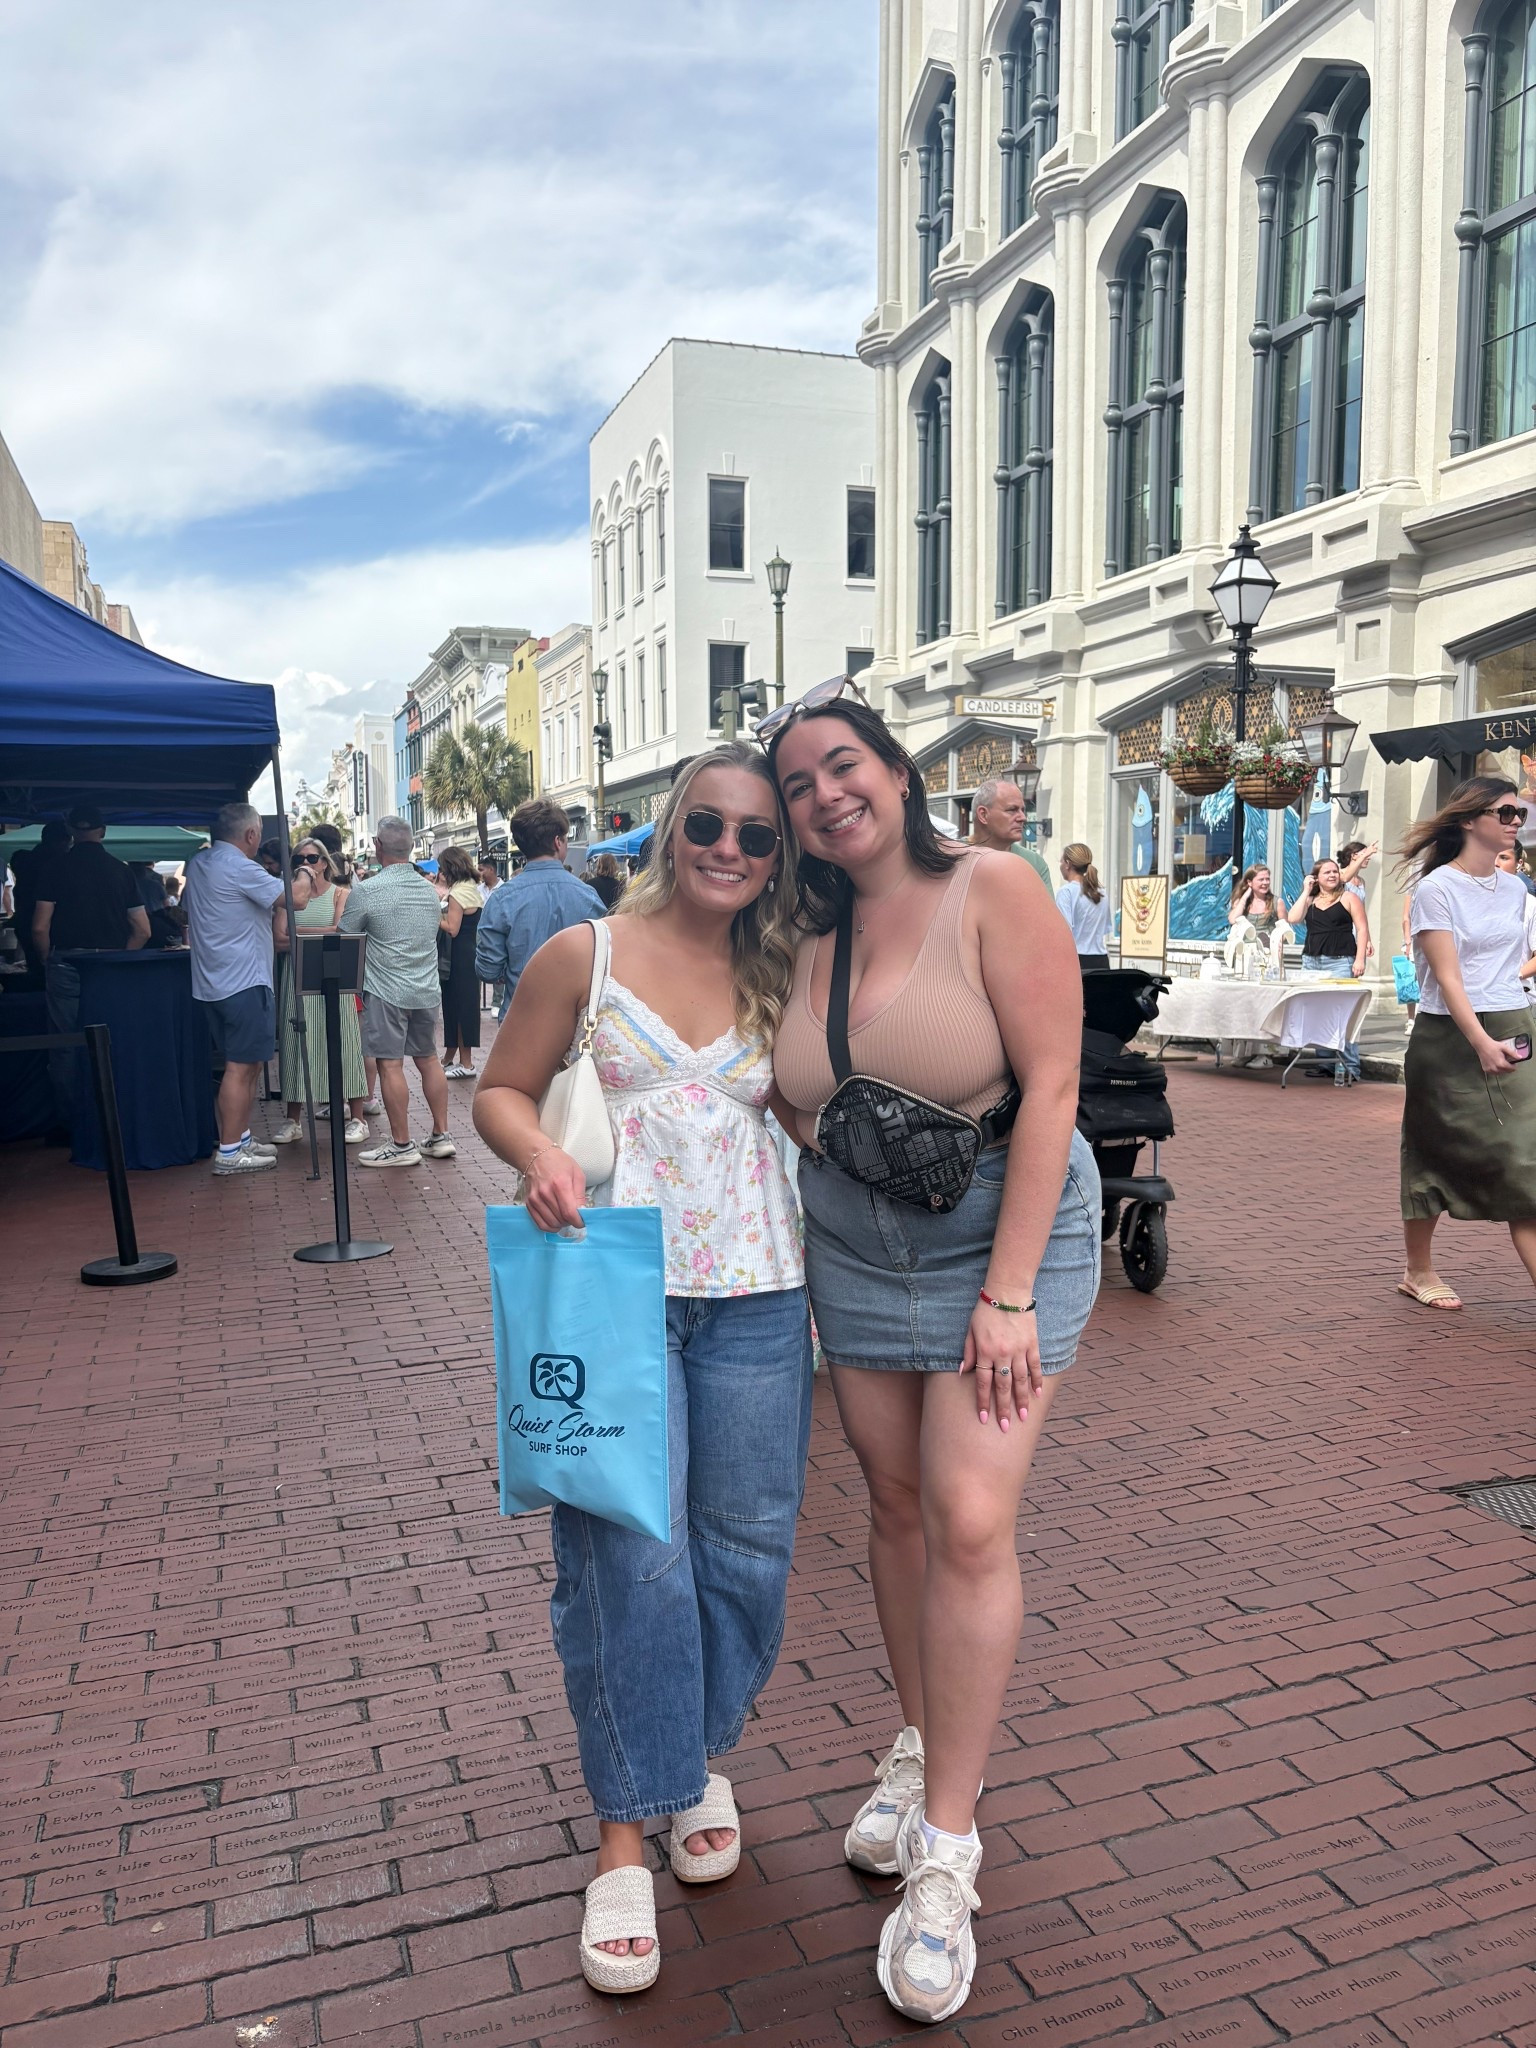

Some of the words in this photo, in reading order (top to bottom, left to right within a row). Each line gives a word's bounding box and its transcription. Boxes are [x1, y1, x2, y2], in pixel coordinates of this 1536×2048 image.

[967, 700, 1039, 714] CANDLEFISH
[1485, 717, 1536, 741] KEN
[508, 1403, 554, 1438] Quiet
[555, 1411, 626, 1442] Storm
[529, 1440, 552, 1454] SURF
[555, 1444, 588, 1457] SHOP
[463, 1511, 500, 1521] Gladwel
[17, 1672, 64, 1686] Garrett
[243, 1680, 264, 1690] Bill
[18, 1692, 73, 1708] Michael
[80, 1682, 128, 1698] Gentry
[756, 1694, 795, 1709] Megan
[851, 1698, 900, 1714] Kenneth
[177, 1713, 207, 1726] Mae
[213, 1704, 260, 1718] Gilmer
[791, 1713, 828, 1728] Grace
[71, 1730, 120, 1746] Gilmer
[241, 1722, 284, 1738] Robert
[305, 1734, 355, 1749] William
[377, 1720, 423, 1737] Gurney
[440, 1727, 503, 1747] Gonzalez
[82, 1754, 122, 1768] Vince
[129, 1745, 179, 1759] Gilmer
[159, 1761, 218, 1780] Michael
[224, 1753, 270, 1768] Gionis
[235, 1776, 268, 1791] John
[275, 1771, 292, 1781] M
[322, 1786, 356, 1800] Dale
[361, 1771, 434, 1792] Gordineer
[48, 1785, 97, 1801] Gionis
[414, 1792, 468, 1811] Stephen
[474, 1780, 526, 1798] Grooms
[52, 1810, 103, 1826] Evelyn
[111, 1805, 124, 1815] A
[497, 1803, 553, 1821] Carolyn
[140, 1820, 198, 1838] Miriam
[29, 1852, 41, 1861] &
[51, 1838, 114, 1856] Whitney
[309, 1846, 368, 1865] Amanda
[374, 1837, 407, 1851] Leah
[412, 1825, 460, 1842] Guerry
[49, 1873, 87, 1888] John
[95, 1868, 108, 1877] &
[117, 1860, 151, 1875] Julie
[159, 1850, 199, 1865] Gray
[1359, 1864, 1408, 1886] Werner
[1411, 1852, 1457, 1873] Erhard
[124, 1889, 165, 1907] Jamie
[171, 1876, 229, 1895] Carolyn
[236, 1863, 287, 1880] Guerry
[1084, 1903, 1116, 1920] Reid
[1119, 1871, 1228, 1911] Cohen-West-Peck
[1457, 1880, 1509, 1903] Norman
[1510, 1877, 1523, 1887] &
[1188, 1887, 1333, 1934] Phebus-Hines-Hawkins
[1420, 1895, 1453, 1912] Hall
[1029, 1945, 1128, 1981] Ralph&Mary
[1129, 1931, 1181, 1955] Briggs
[1430, 1951, 1464, 1969] Amy
[1464, 1946, 1479, 1958] &
[1479, 1933, 1519, 1953] Craig
[1157, 1976, 1192, 1994] Rita
[1193, 1957, 1261, 1983] Donovan
[1261, 1945, 1298, 1963] Hair
[971, 1980, 1014, 2001] Hines
[1291, 1985, 1345, 2010] Hunter
[1348, 1967, 1404, 1993] Hanson
[1001, 2024, 1039, 2042] Olin
[1042, 1995, 1127, 2030] Hammond
[1413, 2003, 1477, 2032] Drayton
[1476, 1986, 1523, 2010] Hastie
[442, 2021, 503, 2043] Pamela
[1181, 2019, 1243, 2043] Hanson
